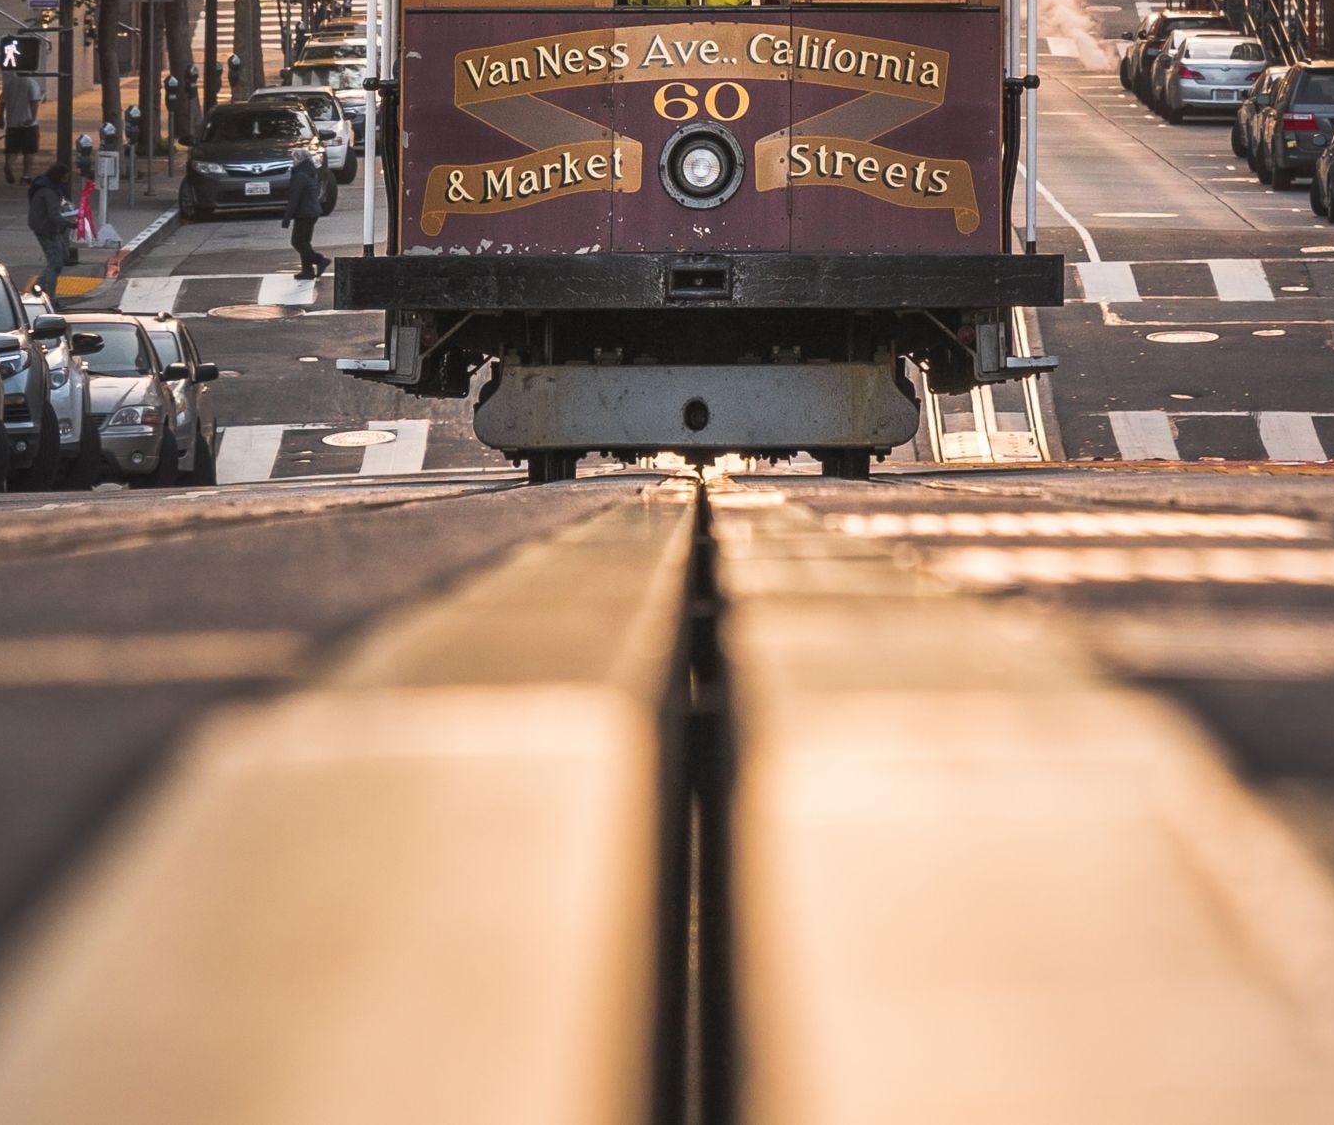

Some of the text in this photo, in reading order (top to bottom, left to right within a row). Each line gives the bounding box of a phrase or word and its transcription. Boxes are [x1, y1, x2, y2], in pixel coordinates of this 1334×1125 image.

[464, 55, 531, 90] Van
[535, 41, 630, 78] Ness
[748, 33, 940, 88] California
[654, 82, 750, 121] 60
[447, 148, 624, 202] & Market
[790, 143, 951, 194] Streets
